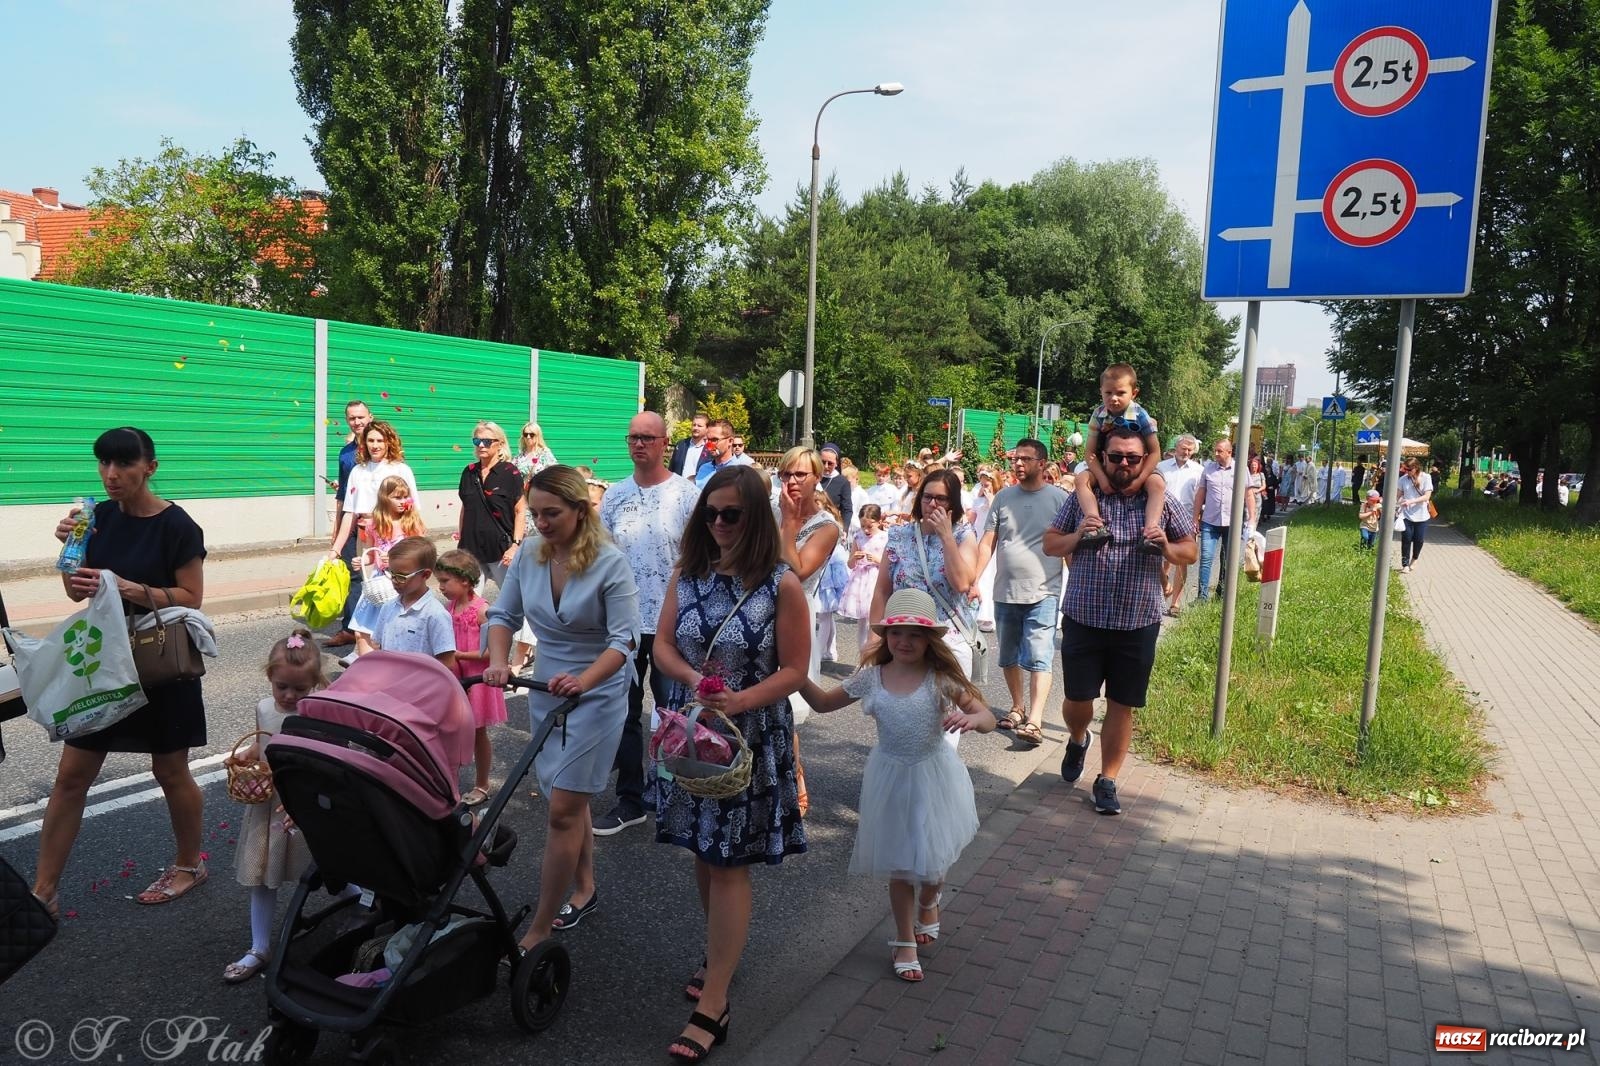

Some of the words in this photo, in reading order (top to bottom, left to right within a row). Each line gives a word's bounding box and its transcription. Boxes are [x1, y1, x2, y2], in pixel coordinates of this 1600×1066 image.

[1351, 56, 1413, 89] 2,5t
[1340, 186, 1401, 220] 2,5t
[1263, 602, 1273, 611] 20
